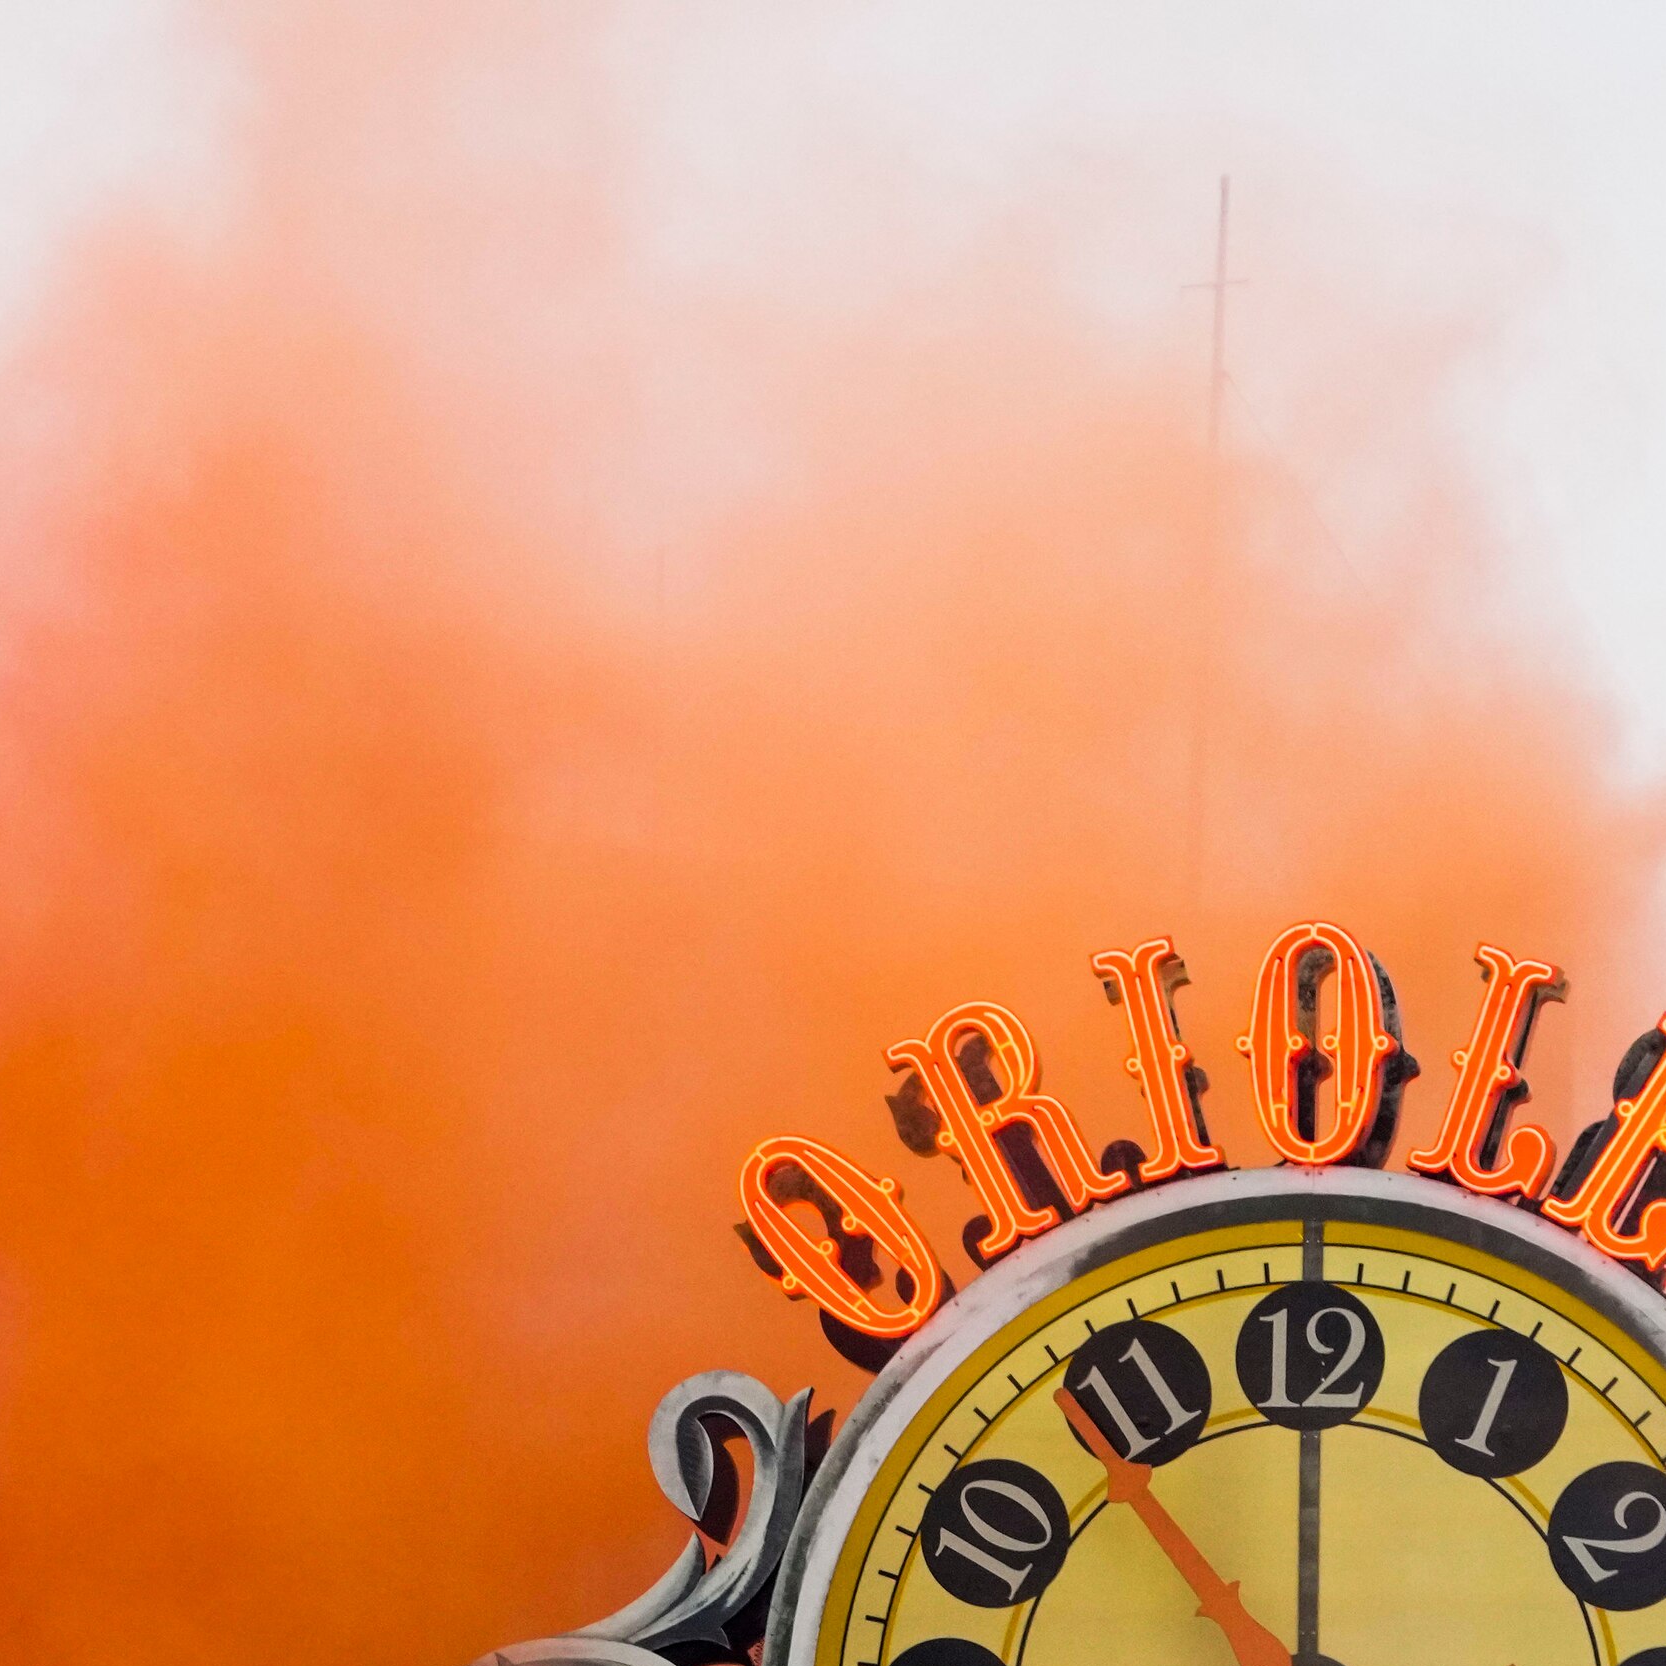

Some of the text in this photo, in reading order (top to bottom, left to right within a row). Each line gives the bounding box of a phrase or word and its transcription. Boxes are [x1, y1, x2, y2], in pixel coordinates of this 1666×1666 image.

[1076, 1337, 1202, 1461] 11
[1259, 1308, 1366, 1408] 12
[1455, 1359, 1518, 1456] 1
[935, 1480, 1053, 1600] 10
